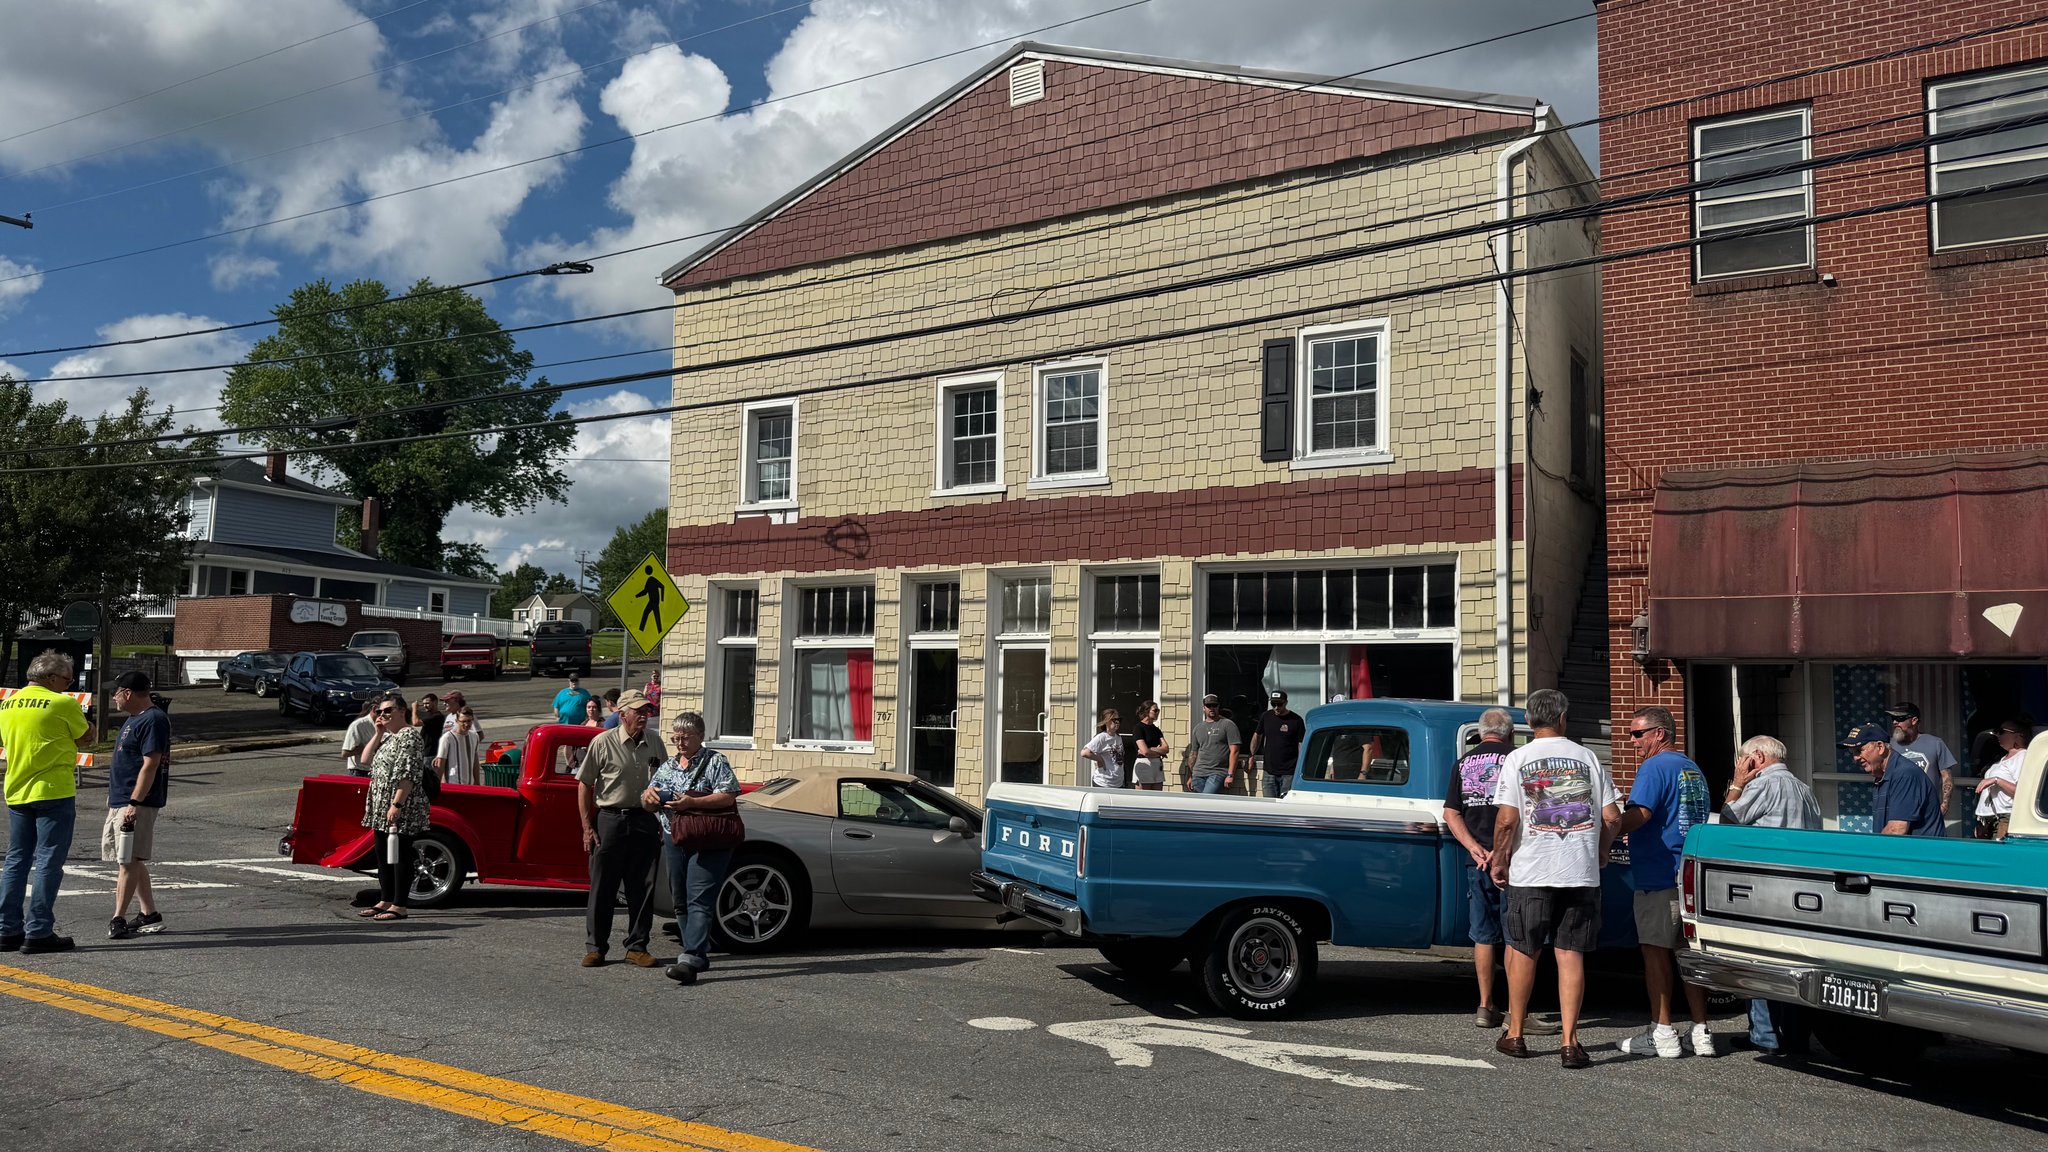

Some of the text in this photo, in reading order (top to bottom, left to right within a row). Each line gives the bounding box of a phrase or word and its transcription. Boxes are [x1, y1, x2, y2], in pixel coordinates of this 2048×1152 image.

[0, 698, 51, 710] ENT STAFF
[877, 712, 892, 721] 707
[1001, 826, 1075, 858] FORD
[1727, 883, 2009, 936] FORD
[1252, 907, 1302, 935] DAYTONA
[1824, 976, 1876, 990] 1970 VIRGINIA
[1240, 997, 1286, 1010] RADIAL
